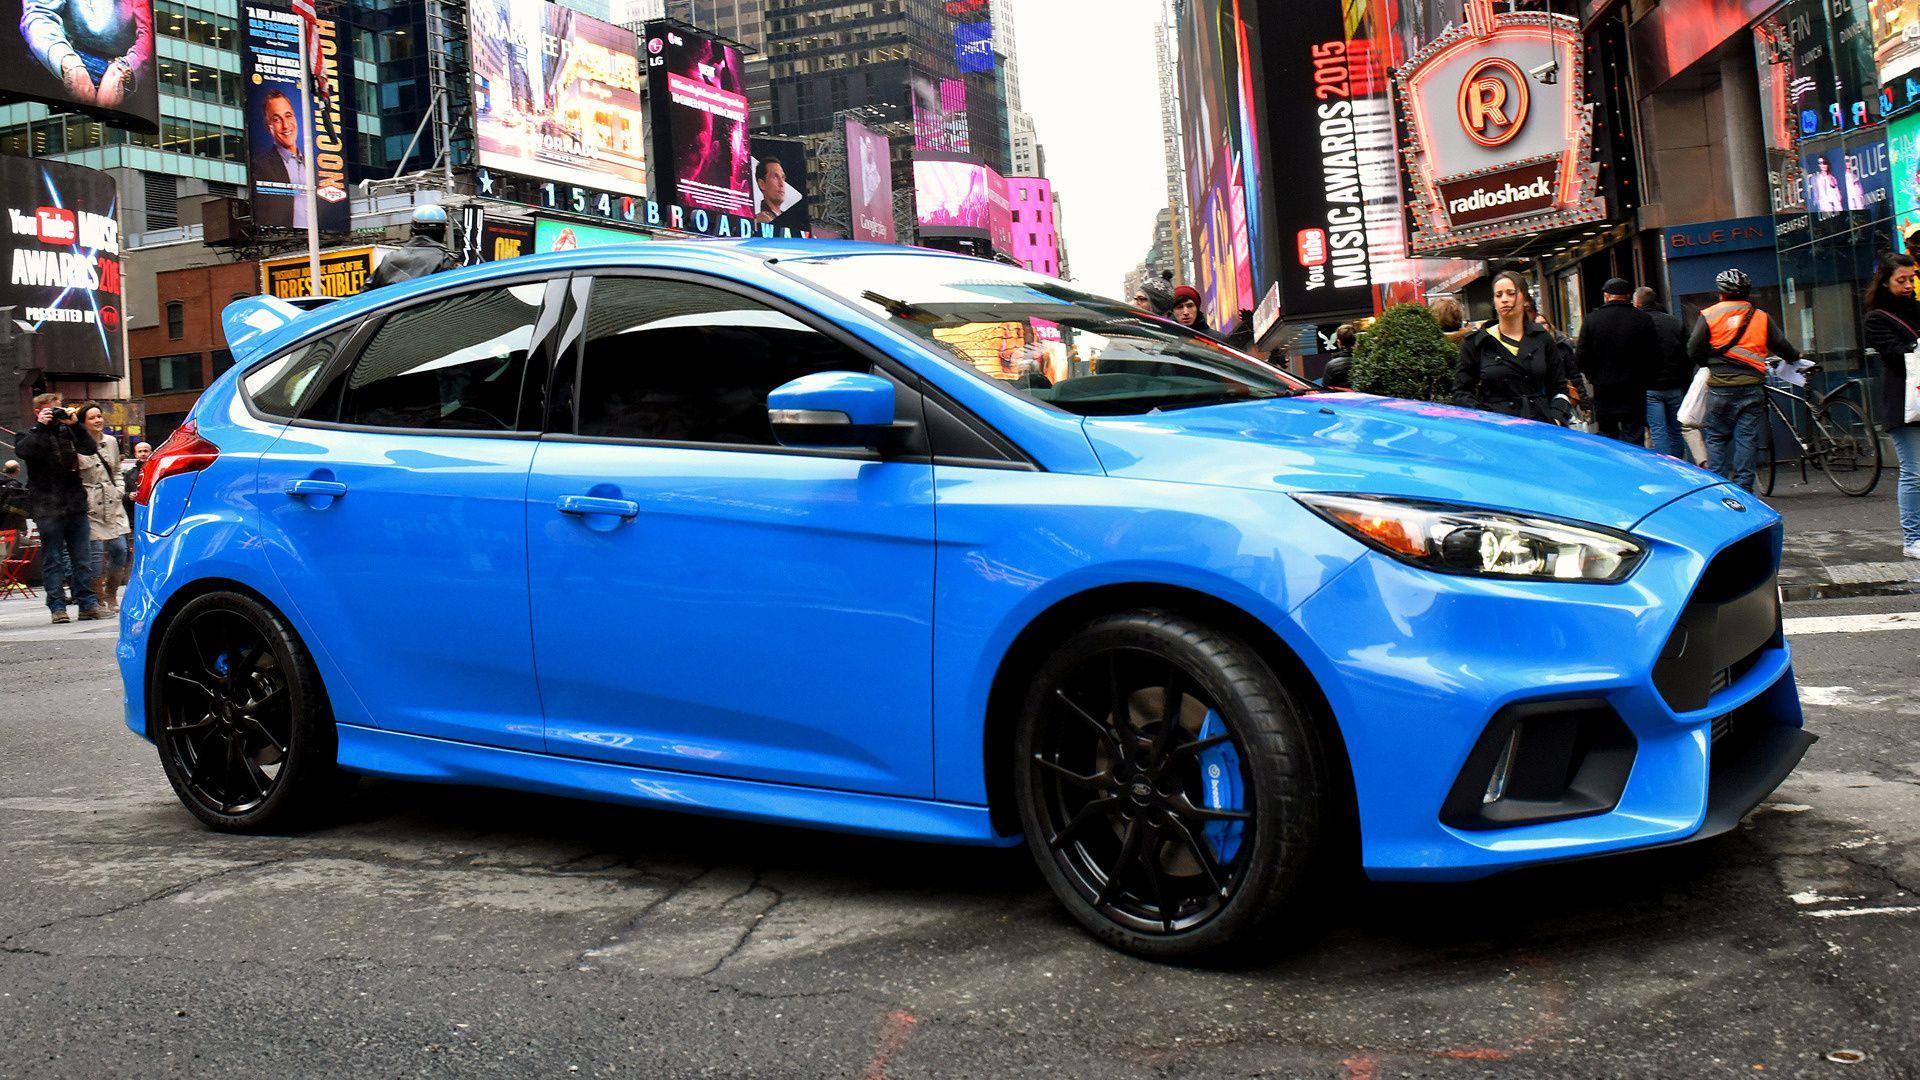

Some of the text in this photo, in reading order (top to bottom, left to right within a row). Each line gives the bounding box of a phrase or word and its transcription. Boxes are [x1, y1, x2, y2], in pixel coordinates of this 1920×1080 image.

[649, 56, 664, 67] LG
[1311, 40, 1368, 289] MUSIC AWARDS 2015
[1849, 142, 1888, 182] BLUE
[541, 183, 636, 220] 1540
[1449, 176, 1551, 214] radioshack
[8, 208, 76, 240] YouTube
[1671, 227, 1763, 247] BLUE FIN
[11, 248, 120, 296] AWARDS 201
[1304, 230, 1326, 291] YouTube
[275, 270, 367, 299] IRRESSTIBLE!
[26, 307, 82, 323] PRESENTED
[1211, 778, 1222, 809] brem
